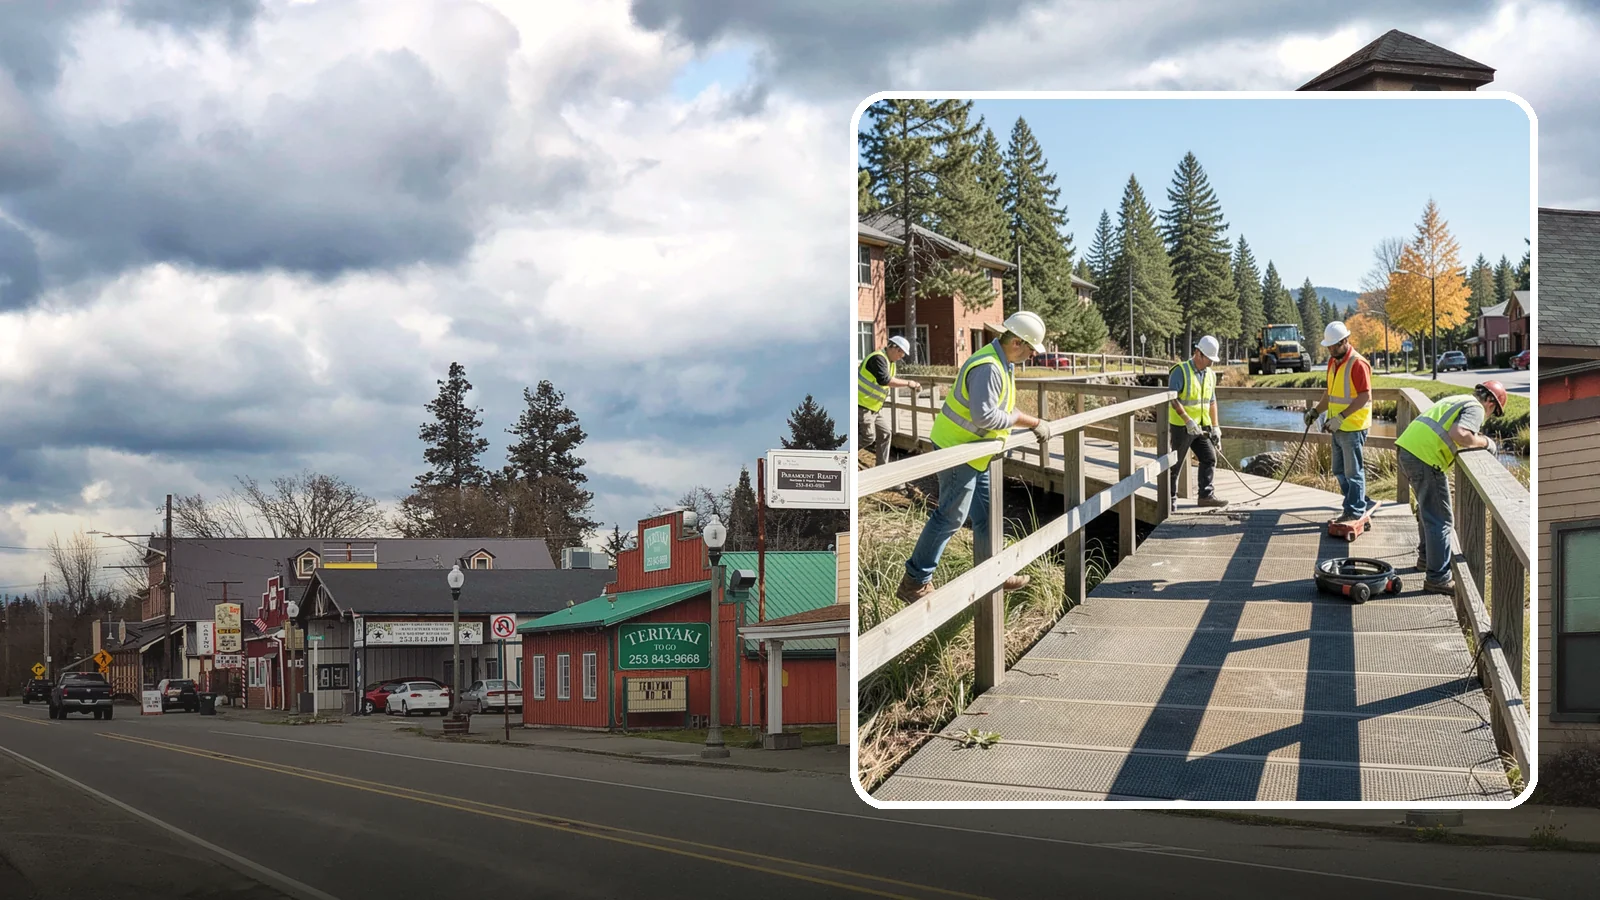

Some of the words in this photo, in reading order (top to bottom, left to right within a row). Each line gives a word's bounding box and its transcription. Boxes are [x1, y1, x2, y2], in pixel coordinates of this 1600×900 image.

[781, 471, 815, 479] PARAMOUNT
[624, 627, 702, 646] TERIYAKI
[628, 654, 649, 665] 253
[651, 653, 700, 664] 843-9668
